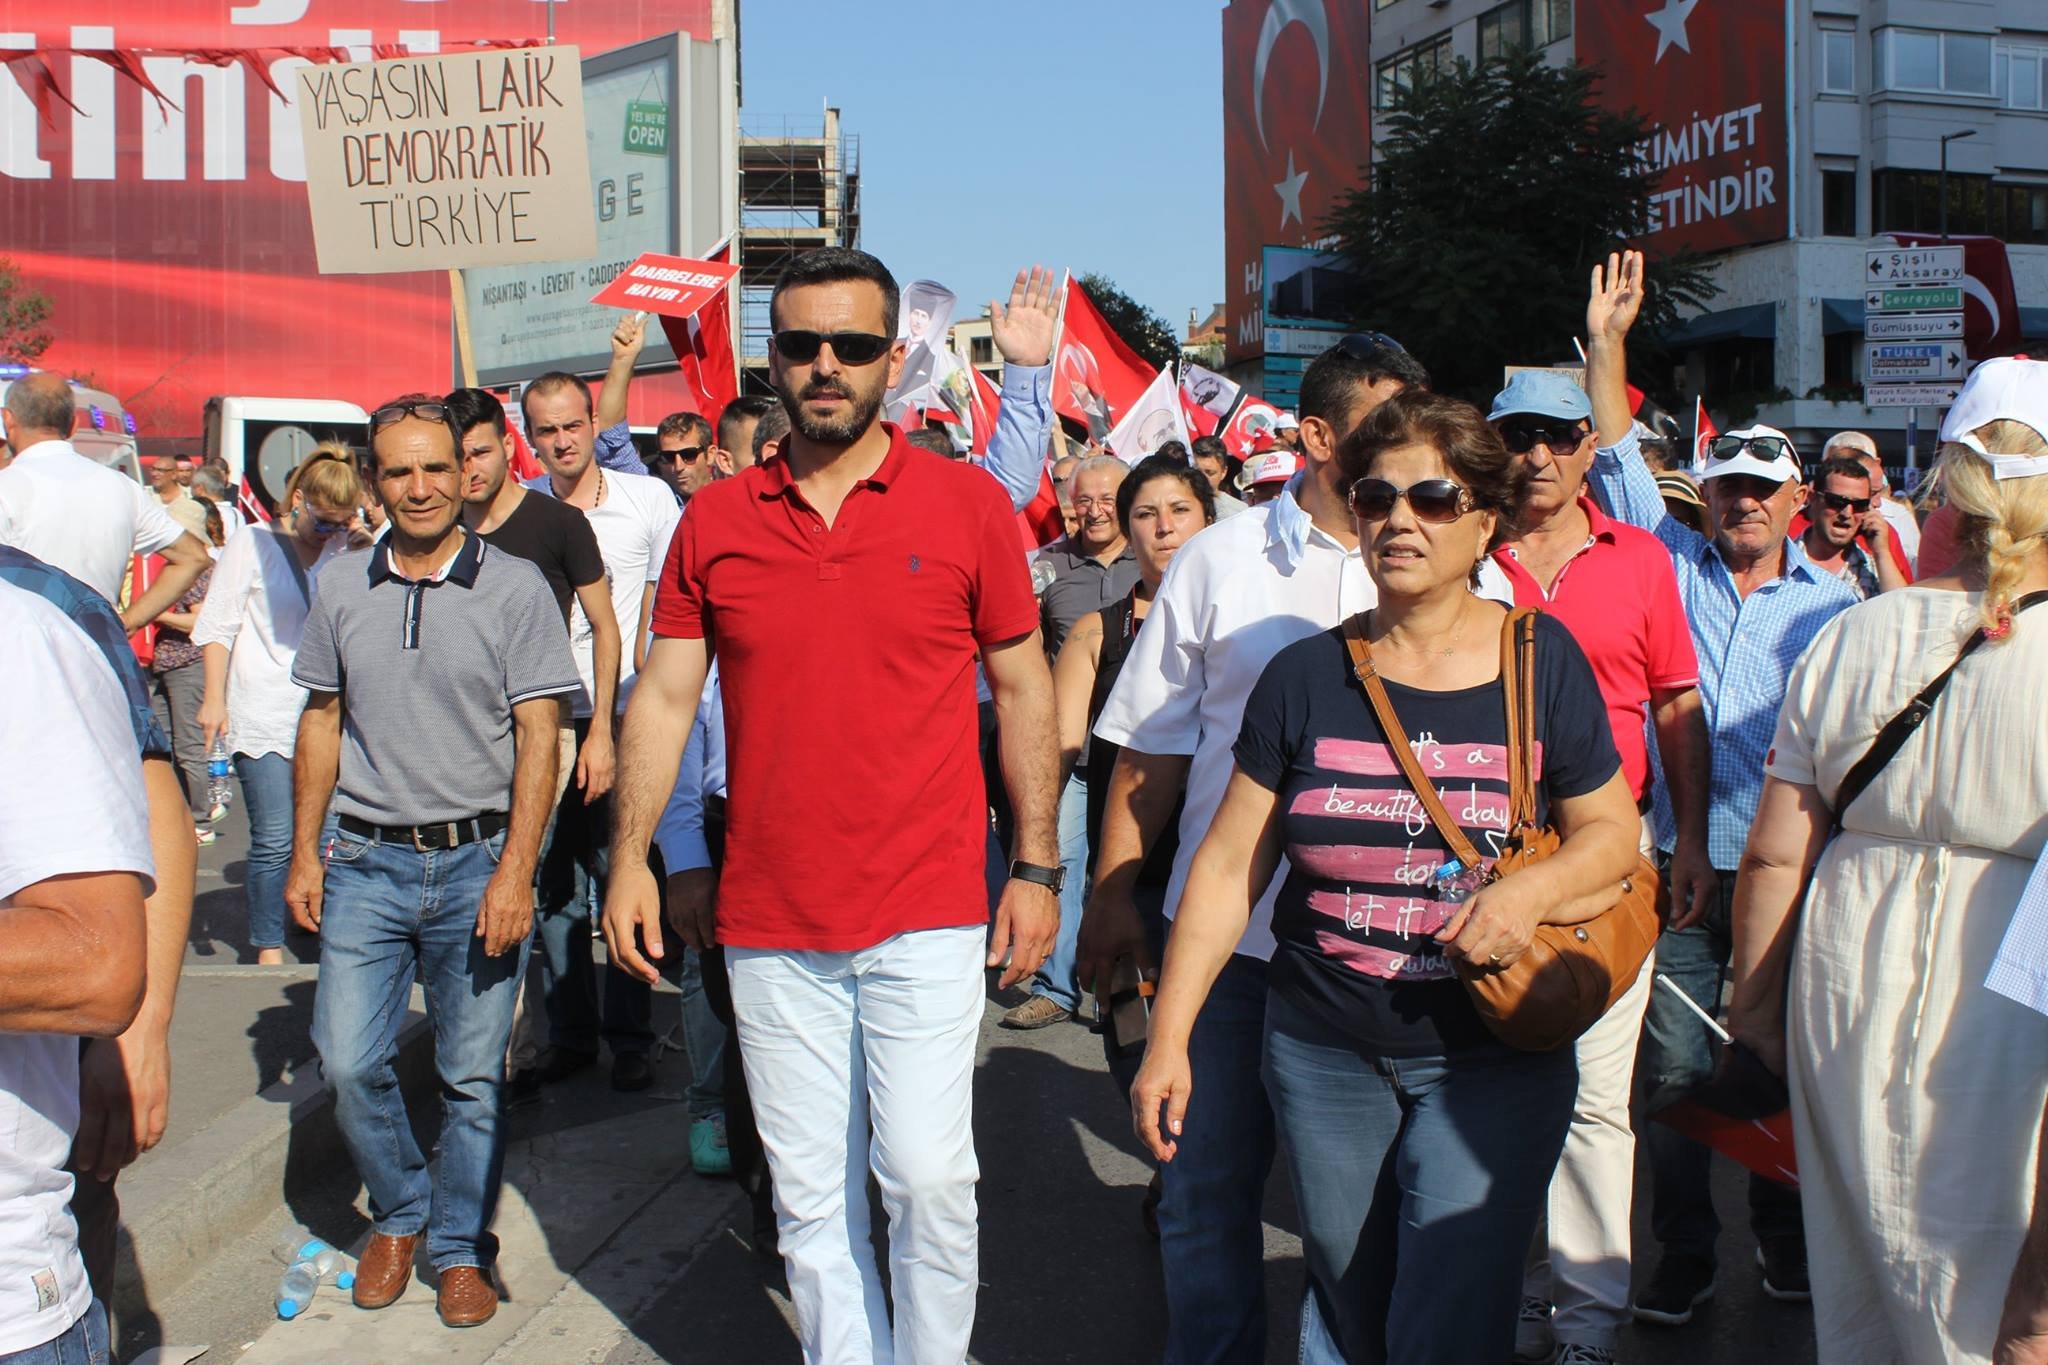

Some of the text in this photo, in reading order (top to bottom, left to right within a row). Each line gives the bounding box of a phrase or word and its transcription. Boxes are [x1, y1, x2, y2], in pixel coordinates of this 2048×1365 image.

[302, 52, 564, 130] YAŞASIN LAİK
[629, 125, 665, 147] OPEN
[631, 111, 643, 124] YES
[342, 115, 551, 188] DEMOKRATİK
[1618, 102, 1762, 177] KİMİYET
[1632, 160, 1777, 236] ETİNDİR
[360, 187, 537, 250] TÜRKİYE
[482, 280, 527, 310] NİŞANTAŞI
[541, 271, 576, 296] LEVENT
[624, 283, 680, 301] HAYIR
[629, 264, 724, 289] DARBELERE
[1890, 267, 1960, 279] Aksaray
[1884, 291, 1955, 306] Çevreyolu
[1467, 749, 1493, 764] a
[1324, 783, 1445, 836] beautif
[1346, 886, 1427, 941] let it
